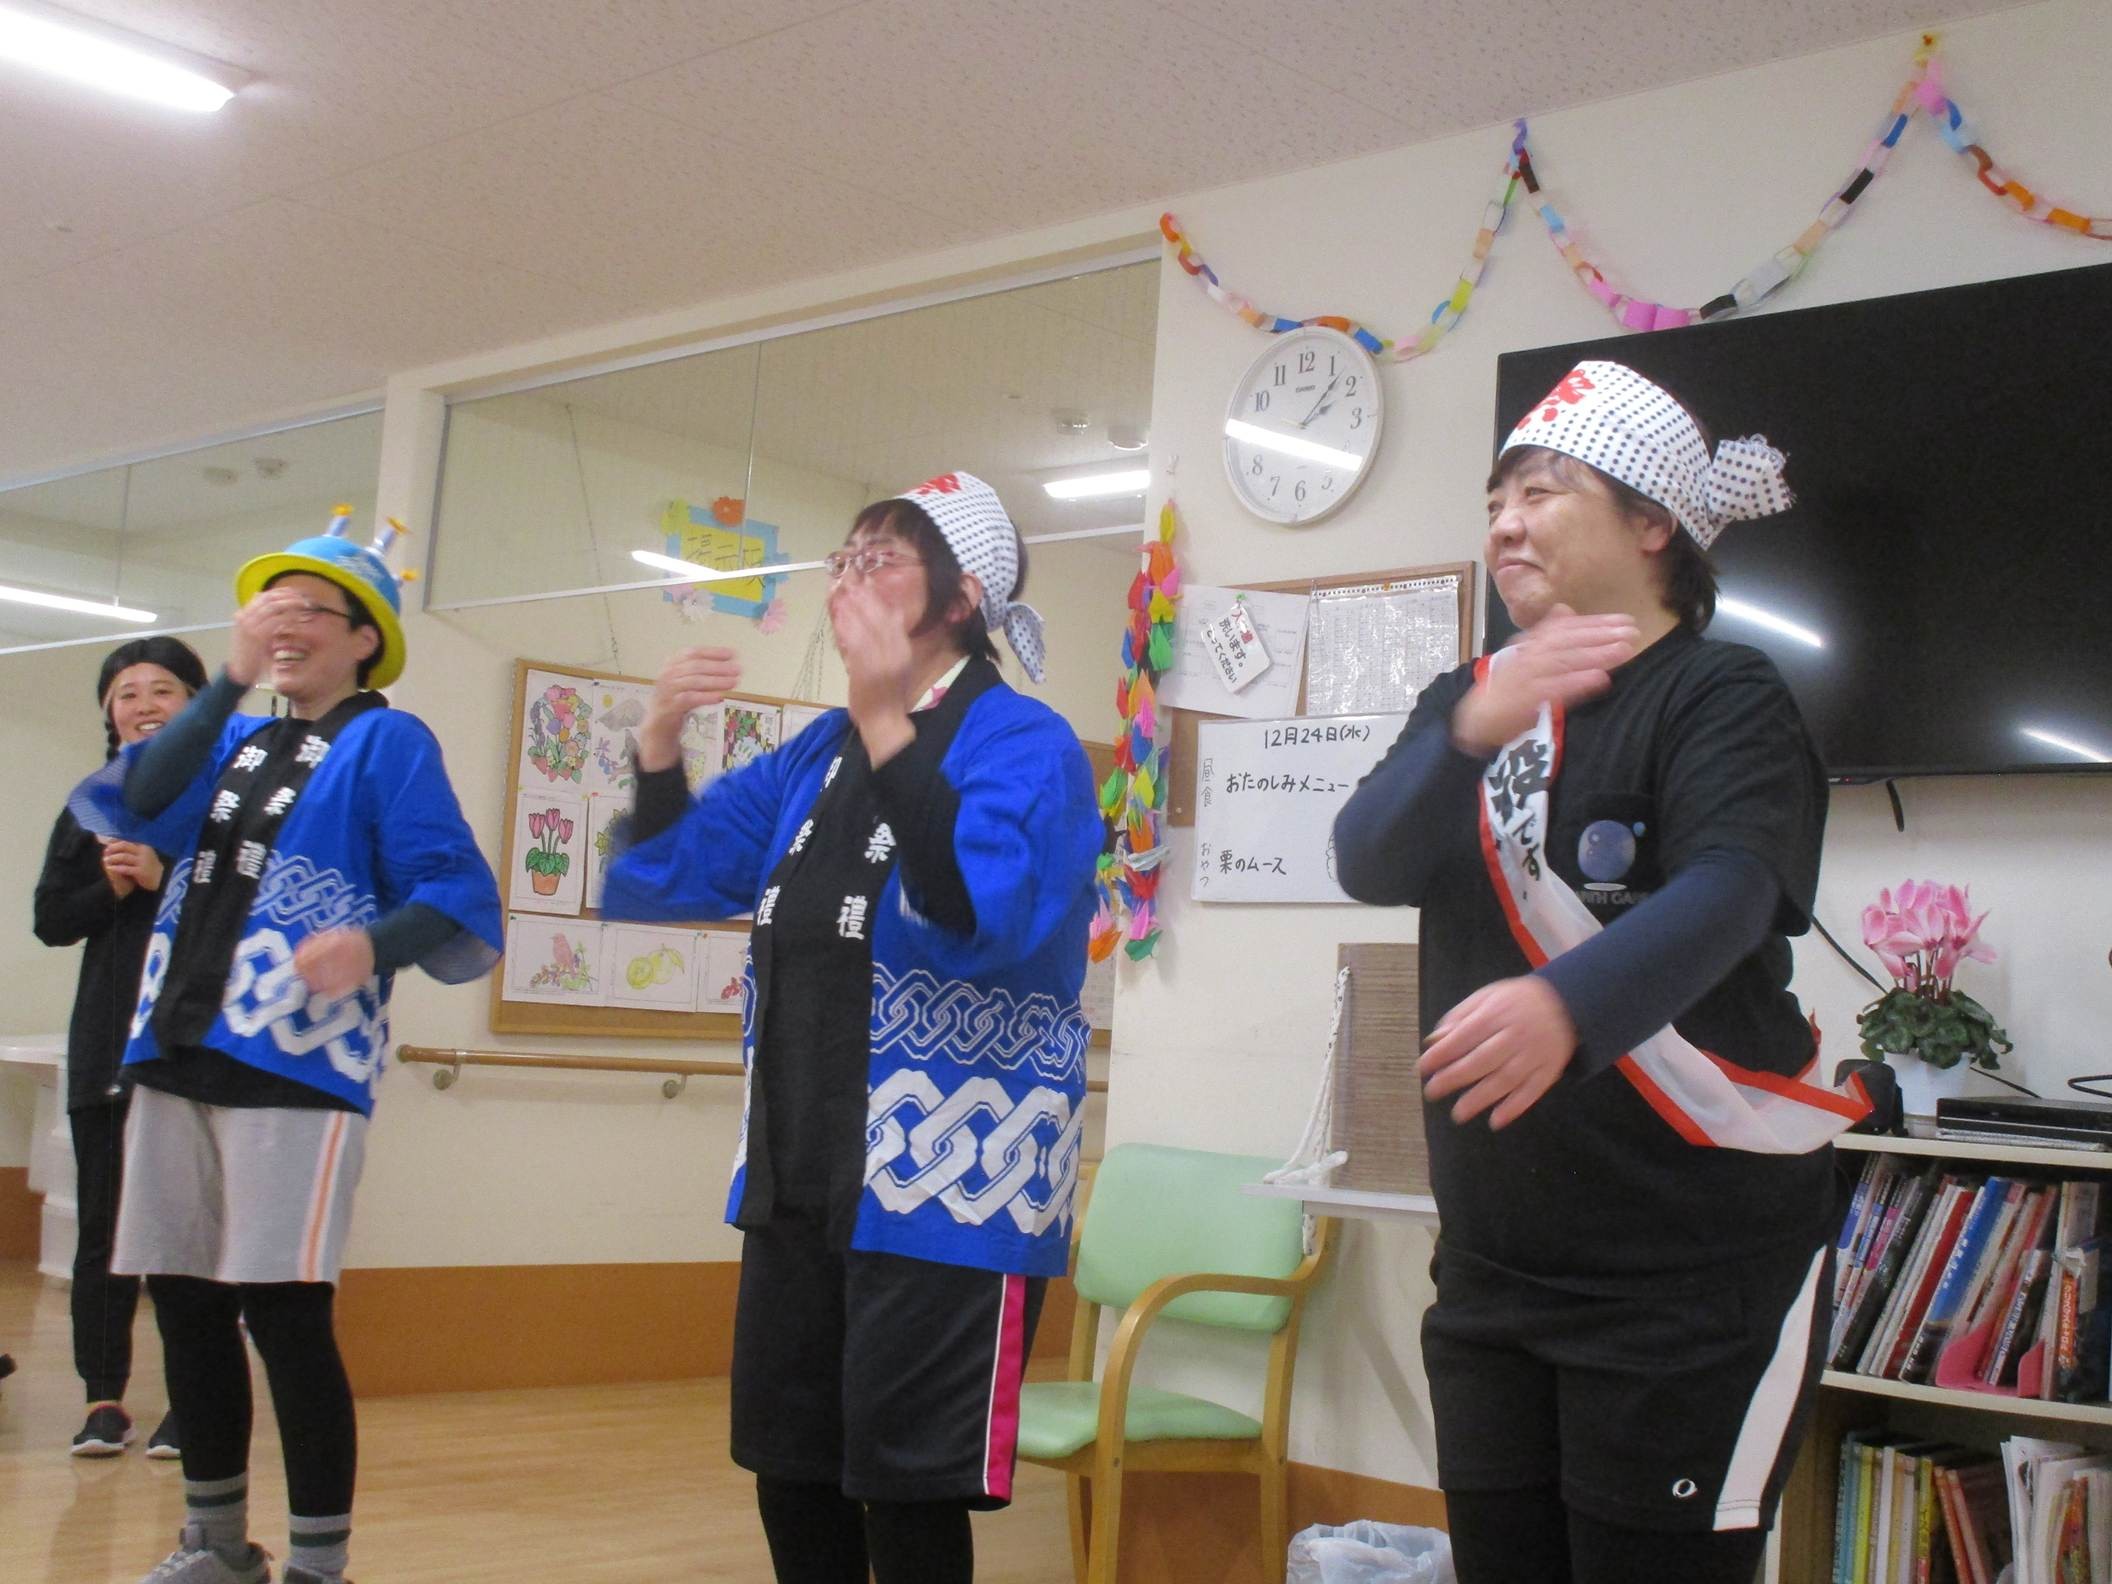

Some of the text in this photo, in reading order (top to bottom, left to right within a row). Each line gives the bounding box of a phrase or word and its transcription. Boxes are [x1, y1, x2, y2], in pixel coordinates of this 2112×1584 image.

[1297, 351, 1315, 374] 12
[1328, 355, 1336, 376] 1
[1273, 364, 1287, 387] 11
[1345, 375, 1357, 398] 2
[1254, 390, 1271, 412] 10
[1350, 407, 1362, 430] 3
[1251, 454, 1263, 476] 8
[1269, 475, 1281, 498] 7
[1294, 480, 1306, 502] 6
[1200, 757, 1215, 808] 昼食
[1225, 771, 1350, 794] おたのしみメニュー
[1199, 842, 1212, 887] おやつ
[1219, 849, 1288, 876] 栗のムース
